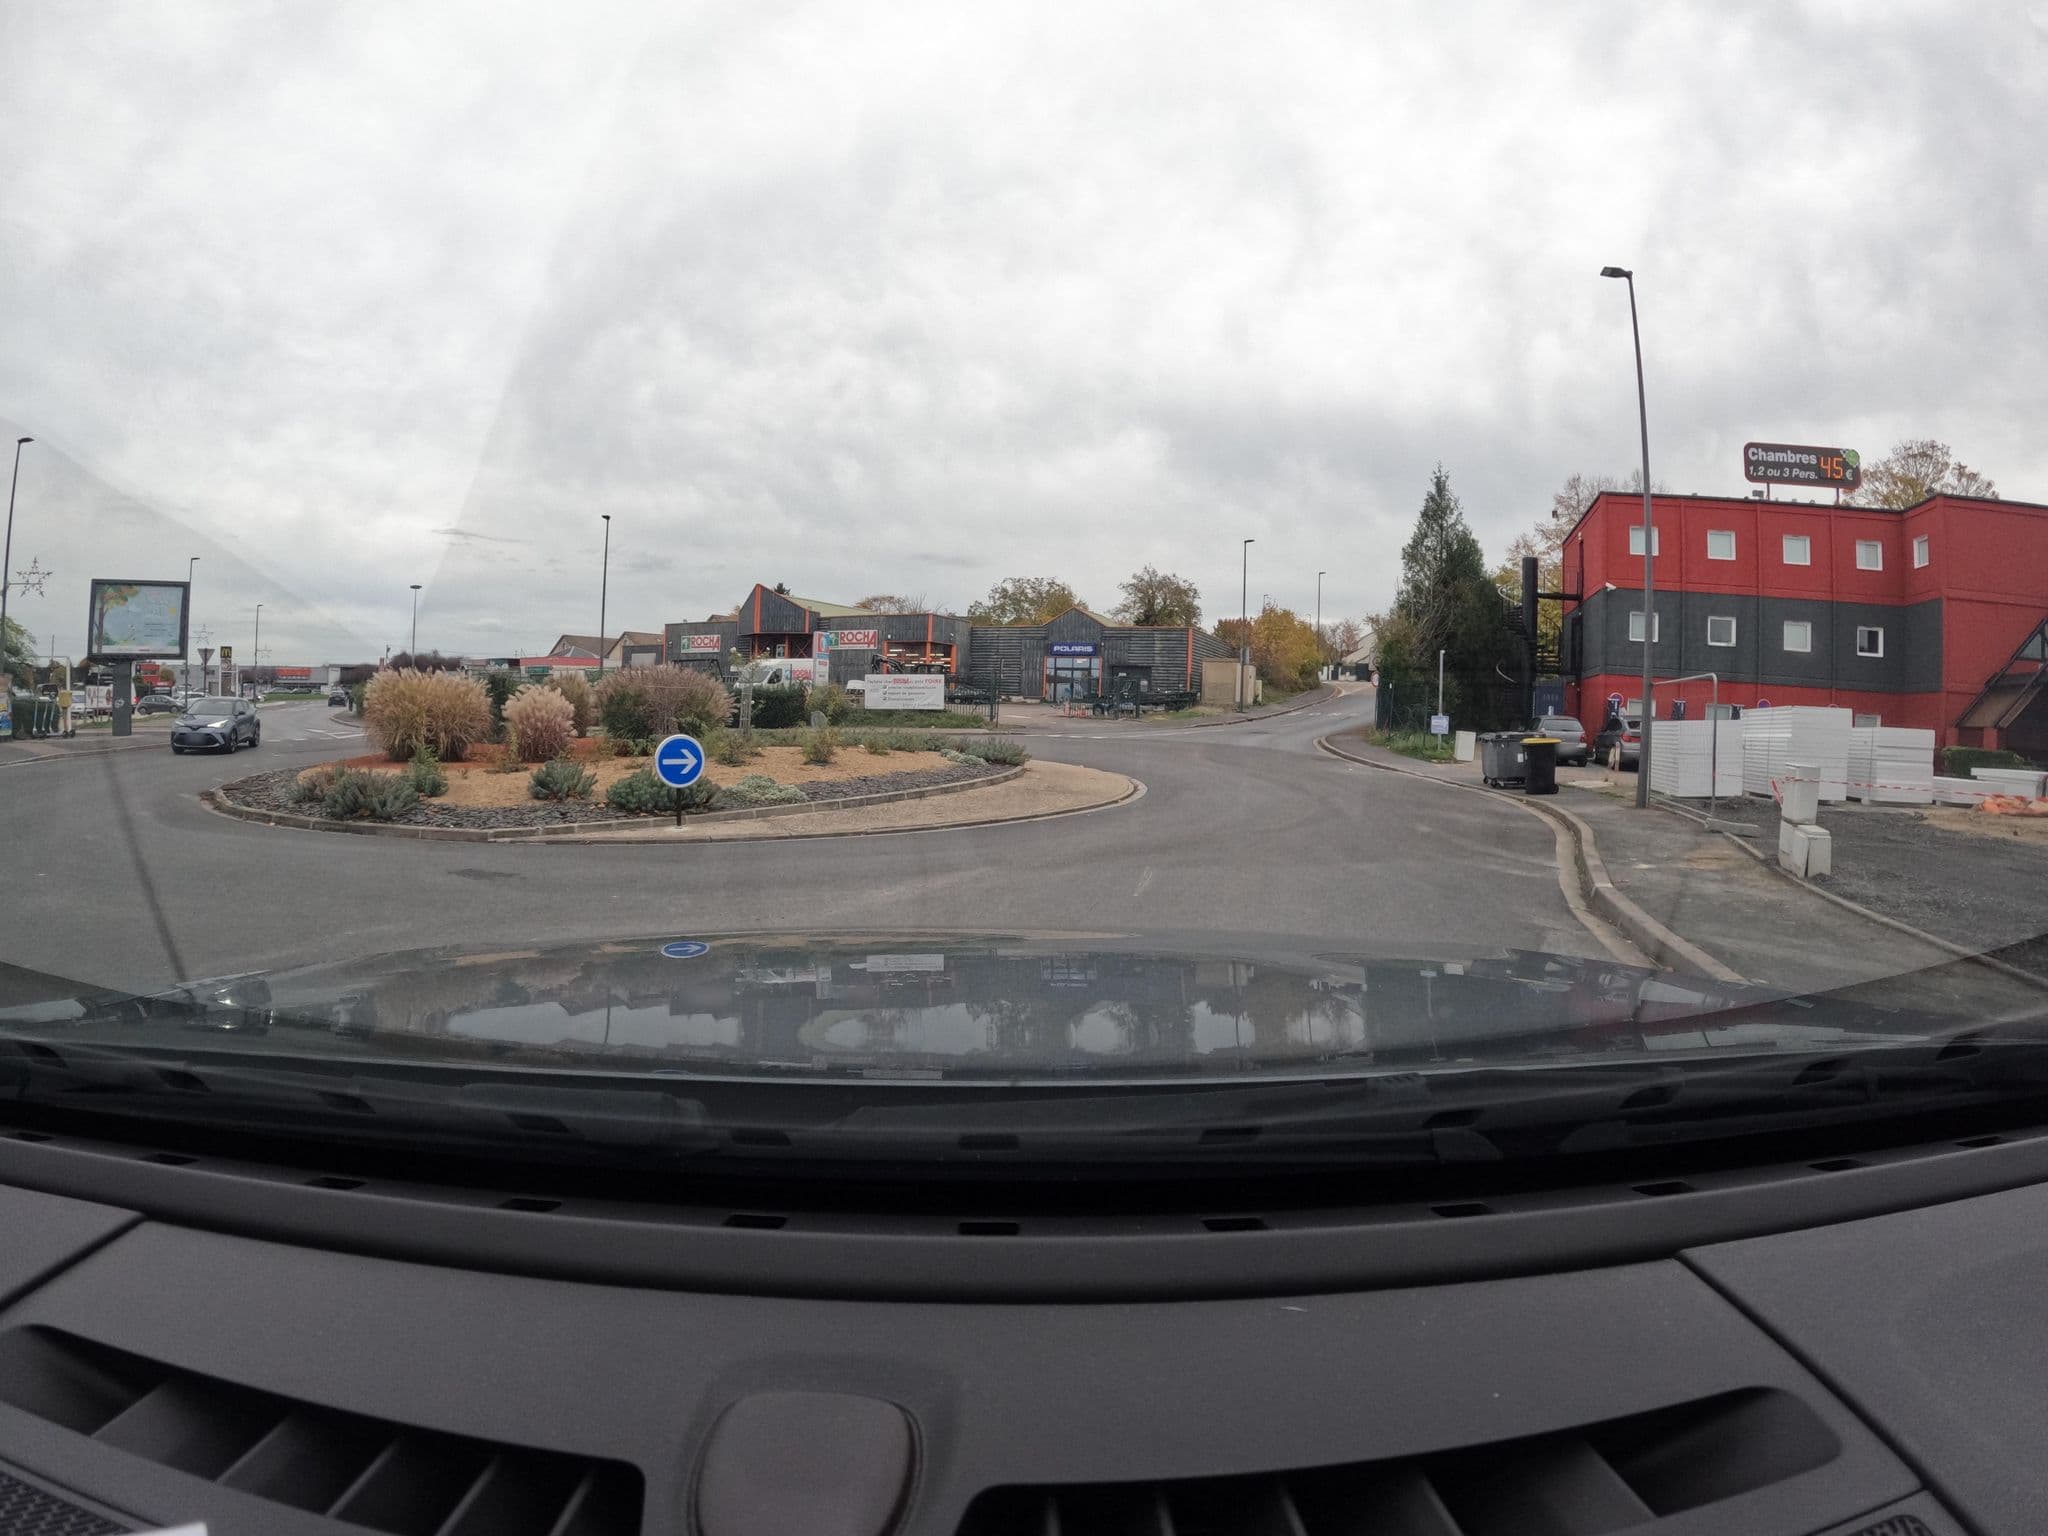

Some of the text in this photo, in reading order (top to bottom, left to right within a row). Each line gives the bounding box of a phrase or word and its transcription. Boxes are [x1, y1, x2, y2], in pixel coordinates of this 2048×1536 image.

[1748, 447, 1844, 479] Chambres 45
[1767, 468, 1780, 477] ou
[1783, 467, 1790, 477] 3
[1792, 468, 1818, 479] Pers.
[691, 636, 720, 651] ROCHA
[840, 631, 876, 648] ROCHA
